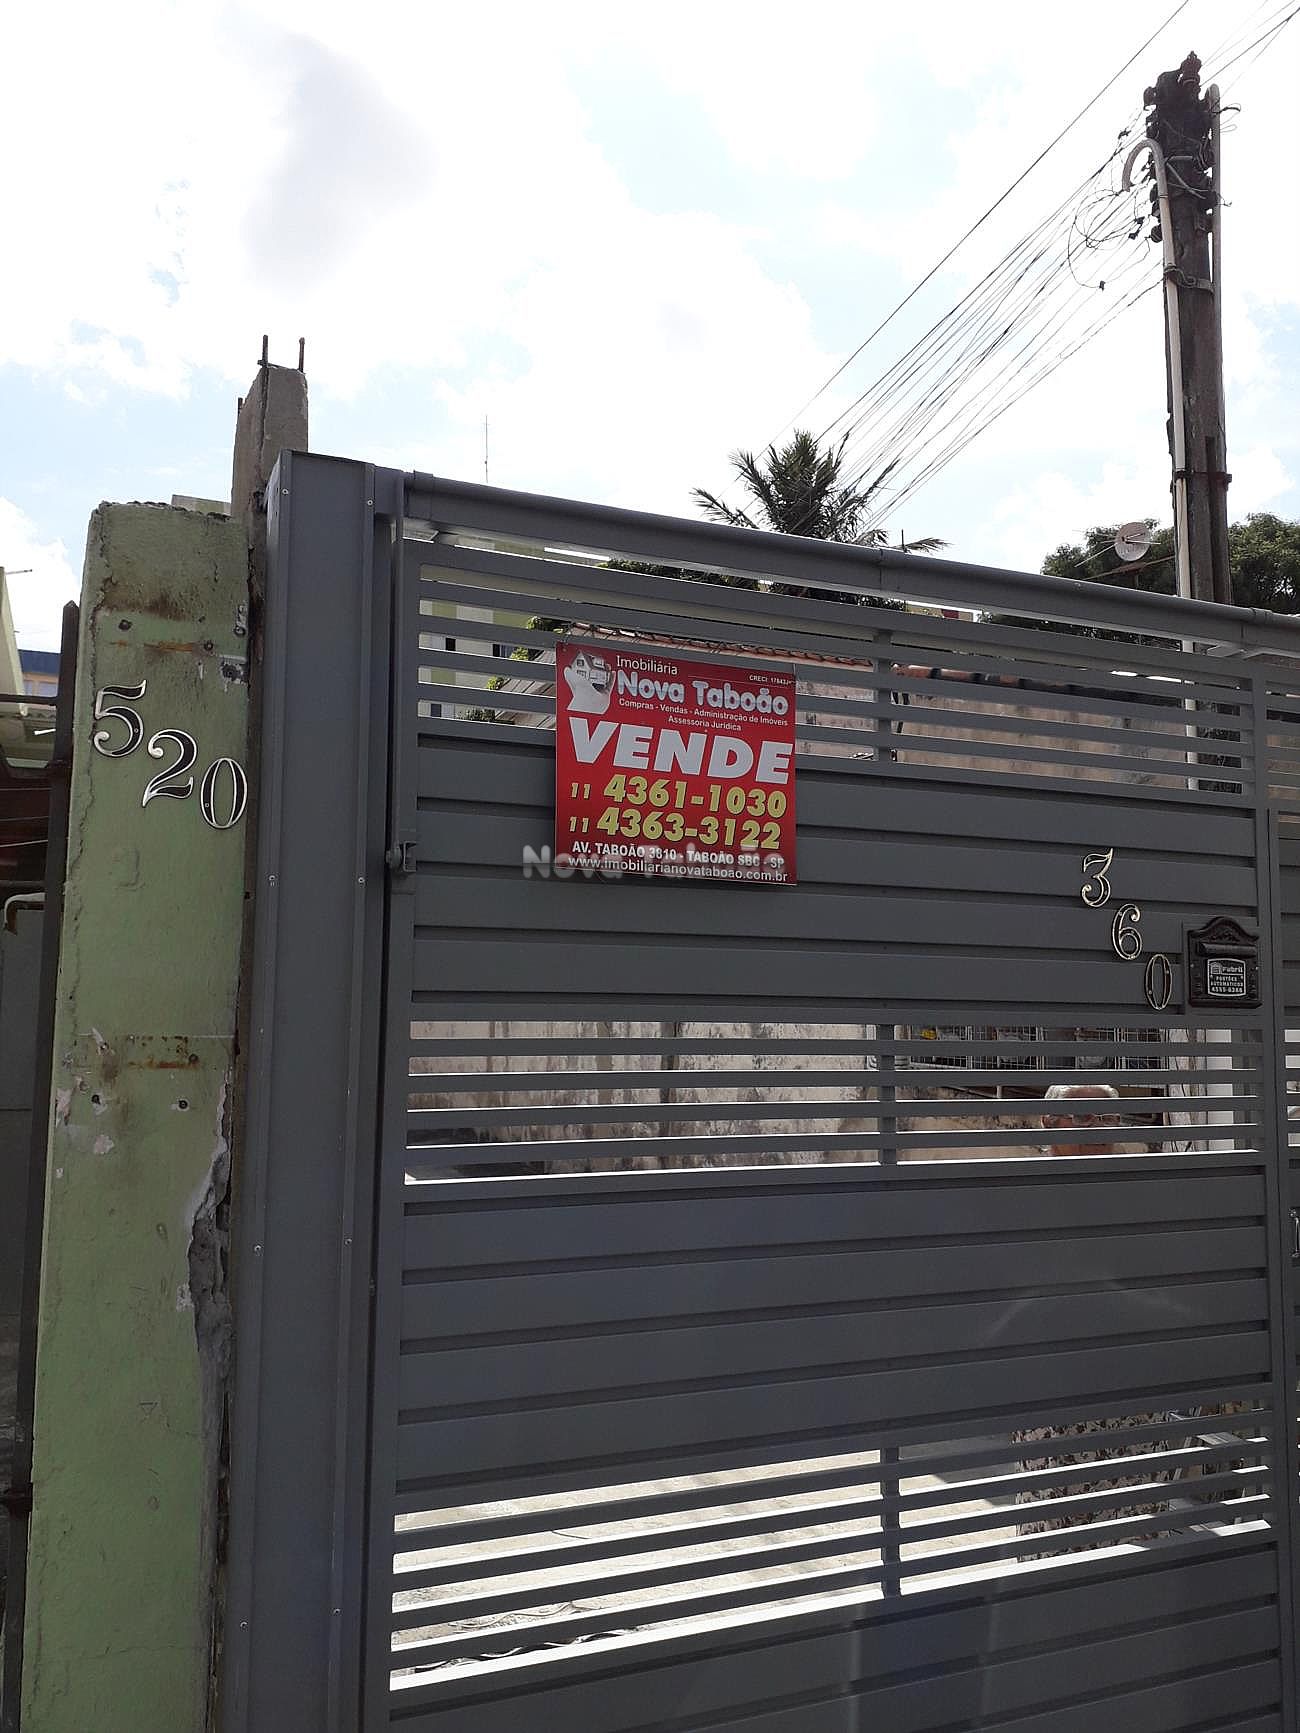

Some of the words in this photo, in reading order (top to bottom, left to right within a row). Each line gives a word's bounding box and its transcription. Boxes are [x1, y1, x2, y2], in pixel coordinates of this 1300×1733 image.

[616, 655, 678, 675] Imobiliária
[749, 674, 768, 682] CRECI
[617, 669, 685, 704] Nova
[692, 680, 789, 716] Taboão
[619, 698, 654, 710] Compras
[660, 705, 688, 715] Vendas
[694, 708, 747, 723] Administração
[749, 715, 759, 724] de
[760, 716, 788, 726] Imóveis
[668, 715, 710, 727] Assessoria
[711, 721, 741, 732] Jurídica
[94, 680, 248, 829] 520
[569, 716, 793, 785] VENDE
[571, 782, 591, 800] 11
[603, 774, 787, 819] 4361-1030
[569, 816, 589, 833] 11
[597, 806, 781, 850] 4363-3122
[568, 857, 788, 882] www.imobiliarianovataboao.com.br
[572, 841, 591, 854] AV.
[595, 842, 645, 858] TABOÃO
[649, 847, 677, 860] 3810
[686, 850, 734, 865] TABOÃO
[770, 857, 784, 869] SP
[1081, 848, 1173, 1010] 360
